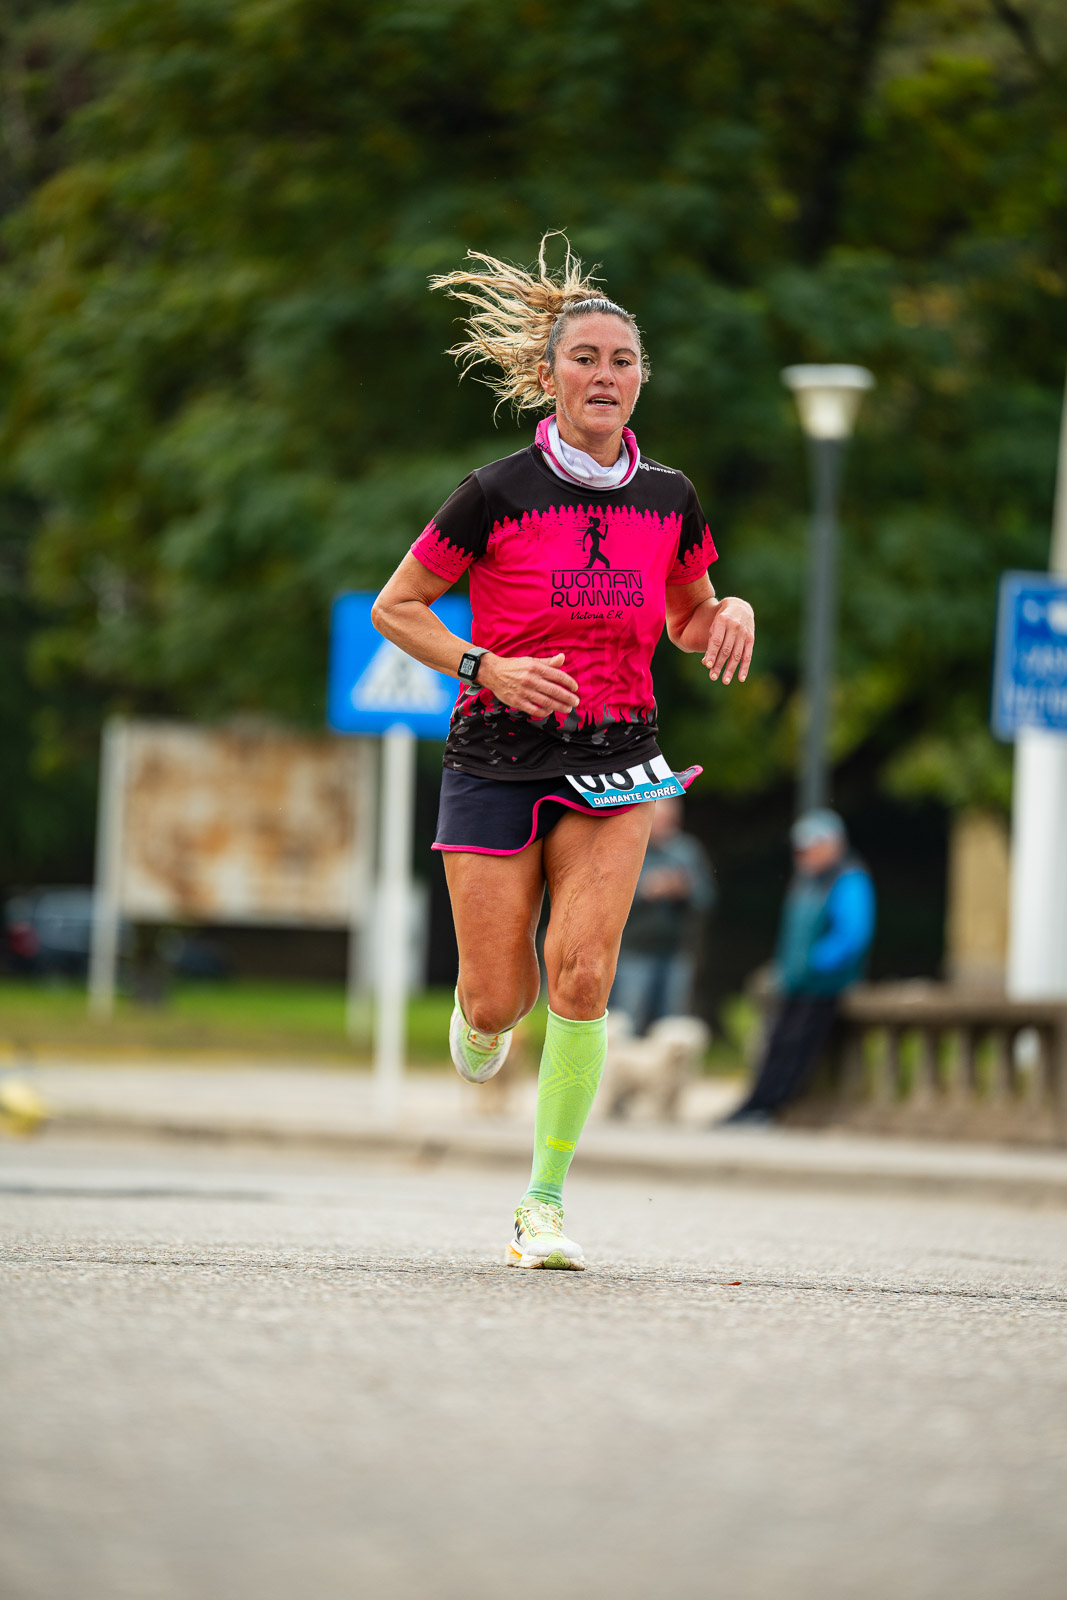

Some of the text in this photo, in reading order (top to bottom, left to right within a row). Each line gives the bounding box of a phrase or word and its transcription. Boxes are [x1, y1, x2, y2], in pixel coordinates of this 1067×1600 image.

[552, 572, 643, 590] WOMAN
[550, 590, 645, 608] RUNNING
[570, 609, 624, 620] Victoria E.R.
[593, 785, 678, 806] DIAMANTE CORRE
